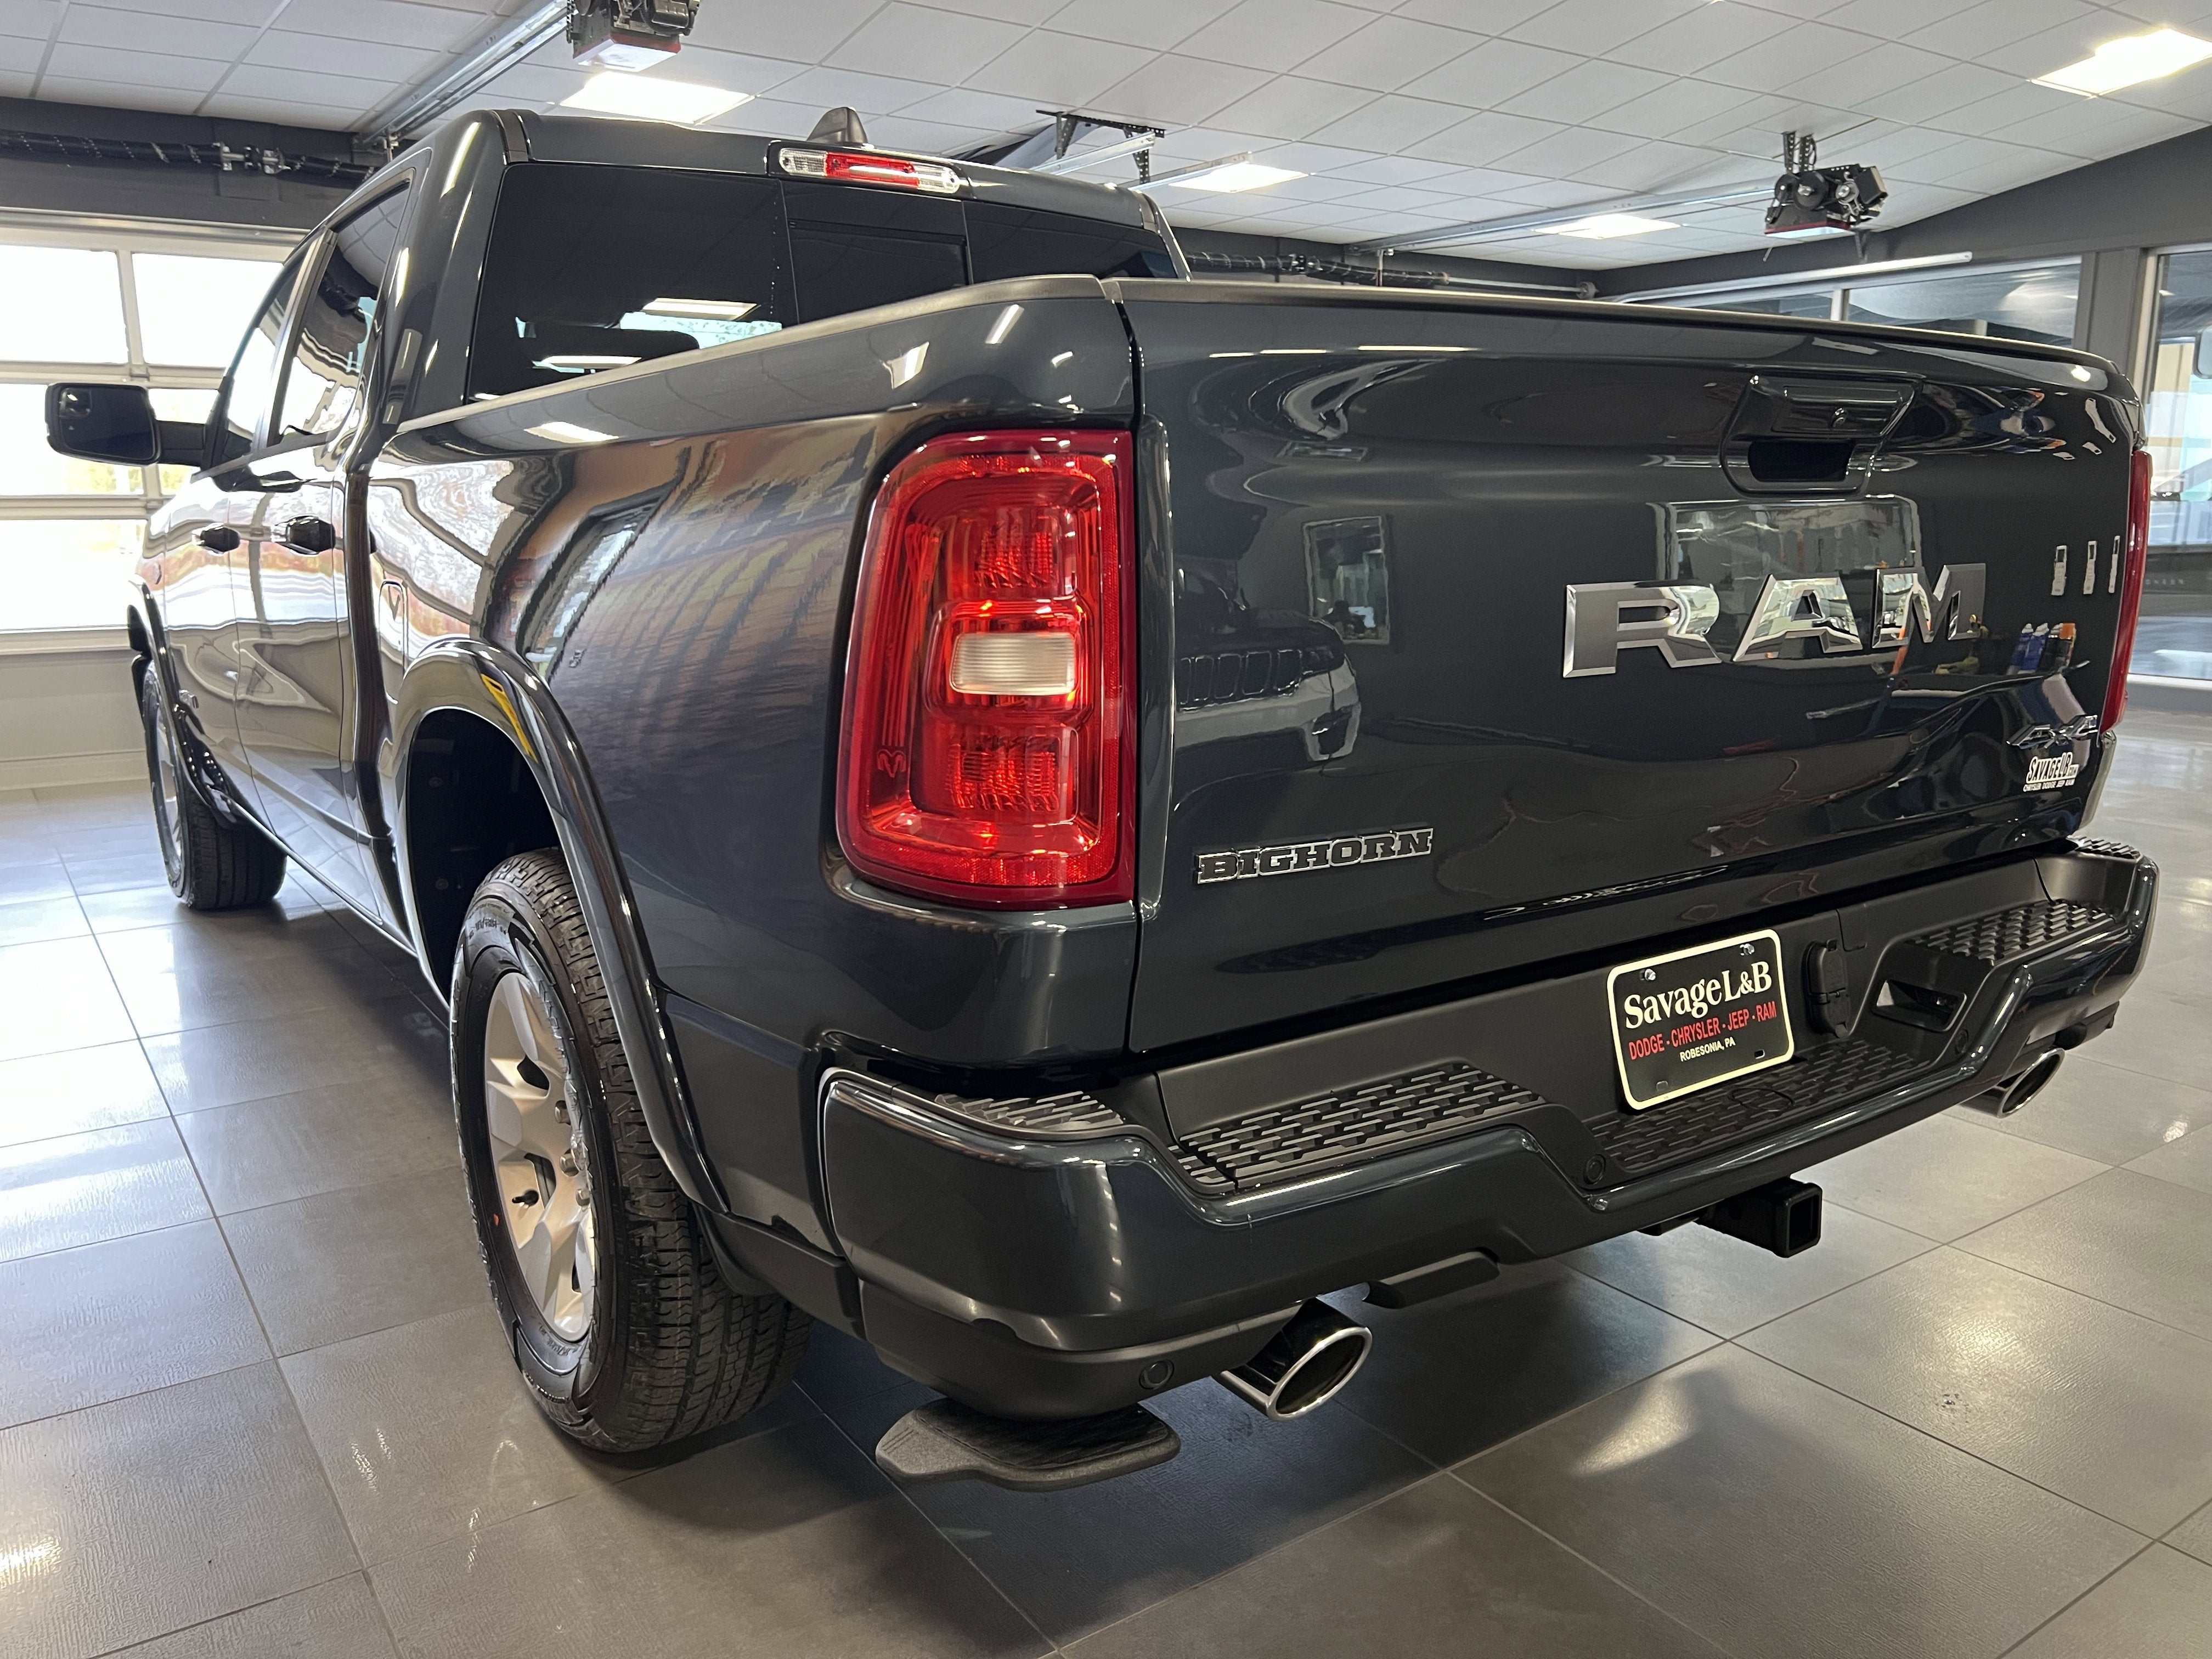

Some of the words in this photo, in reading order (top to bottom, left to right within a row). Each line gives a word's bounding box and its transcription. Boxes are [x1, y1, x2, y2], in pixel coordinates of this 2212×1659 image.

[1563, 563, 1986, 678] RAM
[1197, 828, 1433, 884] BIGHORN
[1628, 1034, 1664, 1060] DODGE
[1671, 1017, 1720, 1048] CHRYSLER
[1728, 1009, 1750, 1031] JEEP
[1756, 1001, 1777, 1022] RAM
[1680, 1040, 1724, 1062] ROBESONIA,
[1724, 1036, 1736, 1048] PA
